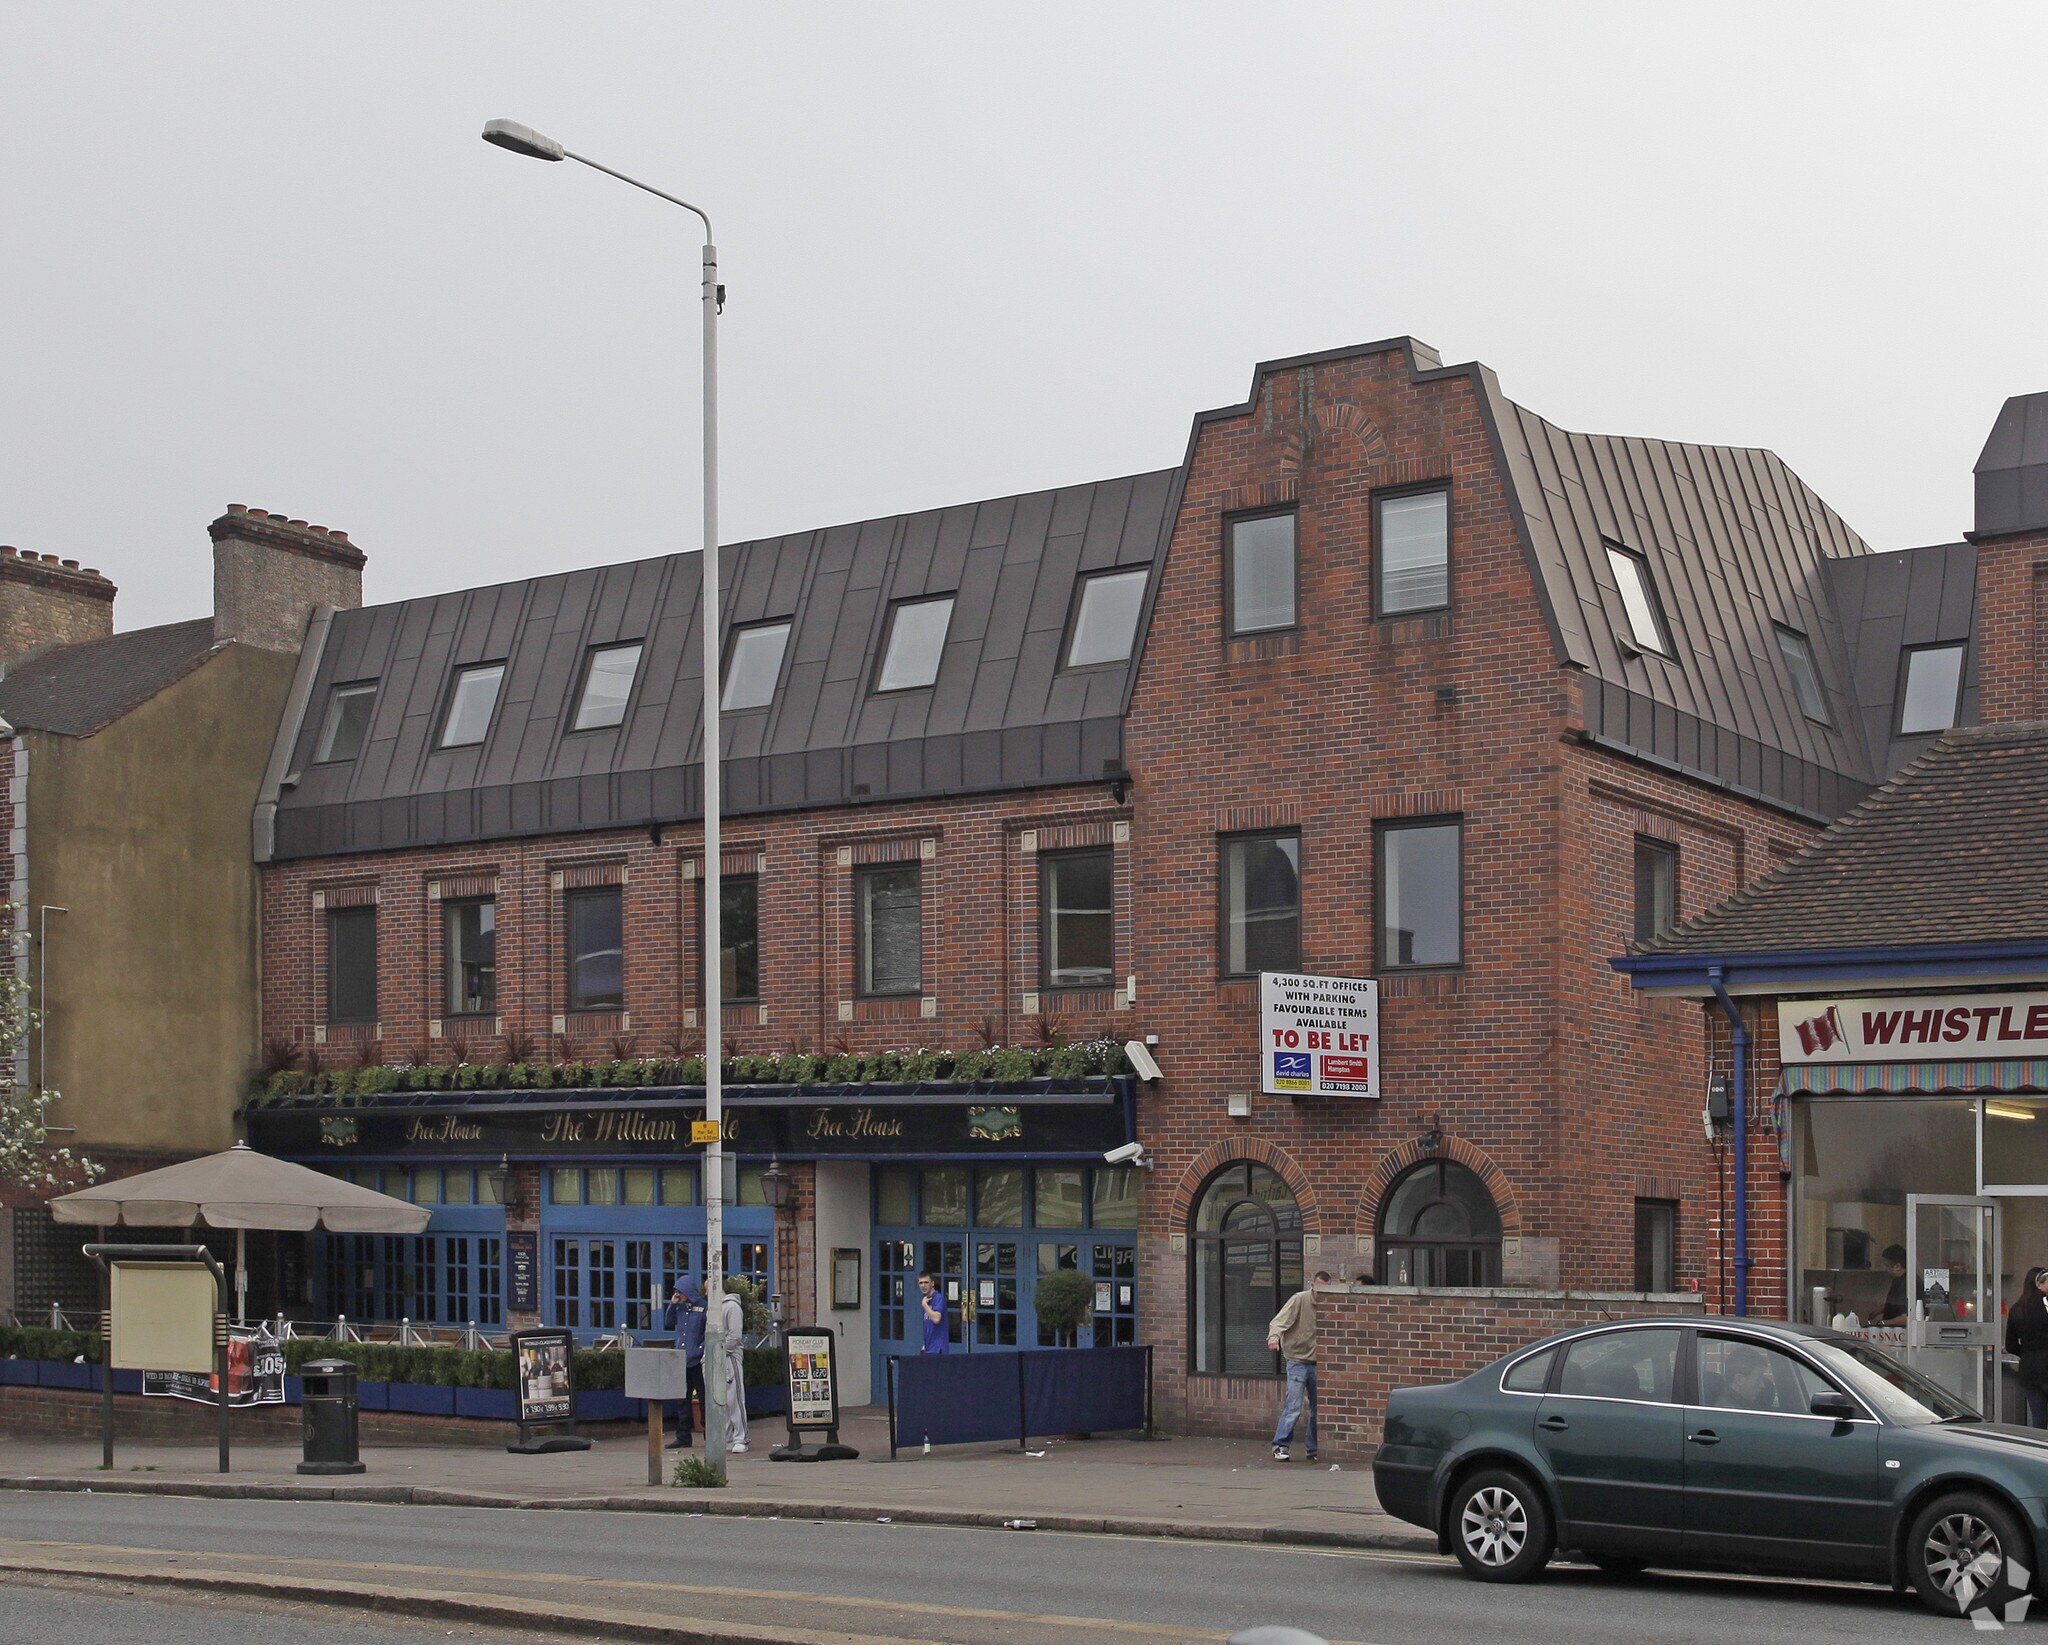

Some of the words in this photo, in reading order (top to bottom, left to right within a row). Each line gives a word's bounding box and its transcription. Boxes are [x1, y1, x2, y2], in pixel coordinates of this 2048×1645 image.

[1272, 977, 1300, 988] 4,300
[1303, 980, 1329, 989] SQ.FT
[1332, 982, 1368, 992] OFFICES
[1286, 991, 1310, 1001] WITH
[1313, 993, 1356, 1004] PARKING
[1274, 1004, 1335, 1016] FAVOURABLE
[1338, 1008, 1367, 1018] TERMS
[1296, 1018, 1347, 1029] AVAILABLE
[1862, 1005, 2048, 1044] WHISTLE
[1273, 1029, 1299, 1048] TO
[1308, 1031, 1331, 1050] BE
[1339, 1033, 1369, 1052] LET
[1322, 1082, 1334, 1090] 020
[436, 1115, 481, 1143] House
[541, 1112, 585, 1141] The
[588, 1111, 676, 1141] William
[806, 1108, 844, 1139] Free
[846, 1108, 904, 1139] House
